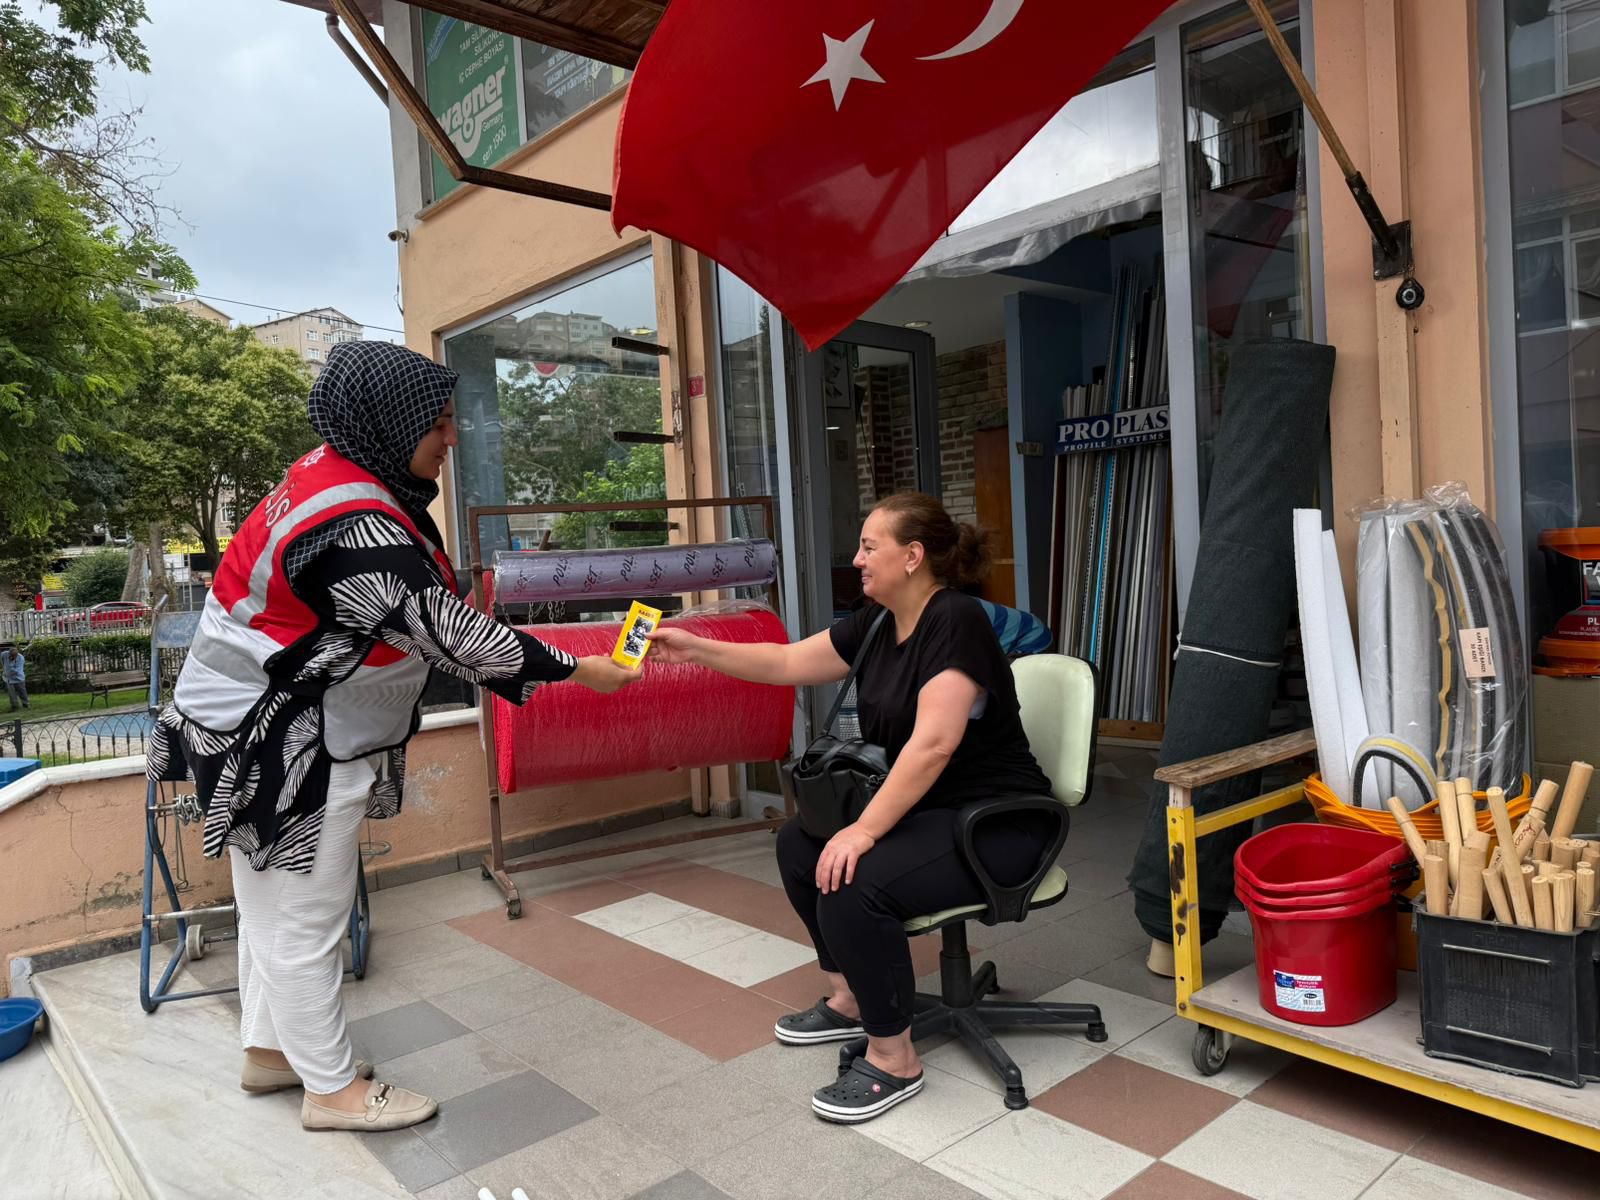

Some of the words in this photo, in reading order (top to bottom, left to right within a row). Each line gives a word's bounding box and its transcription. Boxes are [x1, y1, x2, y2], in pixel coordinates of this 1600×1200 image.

[436, 66, 506, 139] wagner
[1063, 440, 1107, 452] PROFILE
[1115, 432, 1165, 446] SYSTEMS
